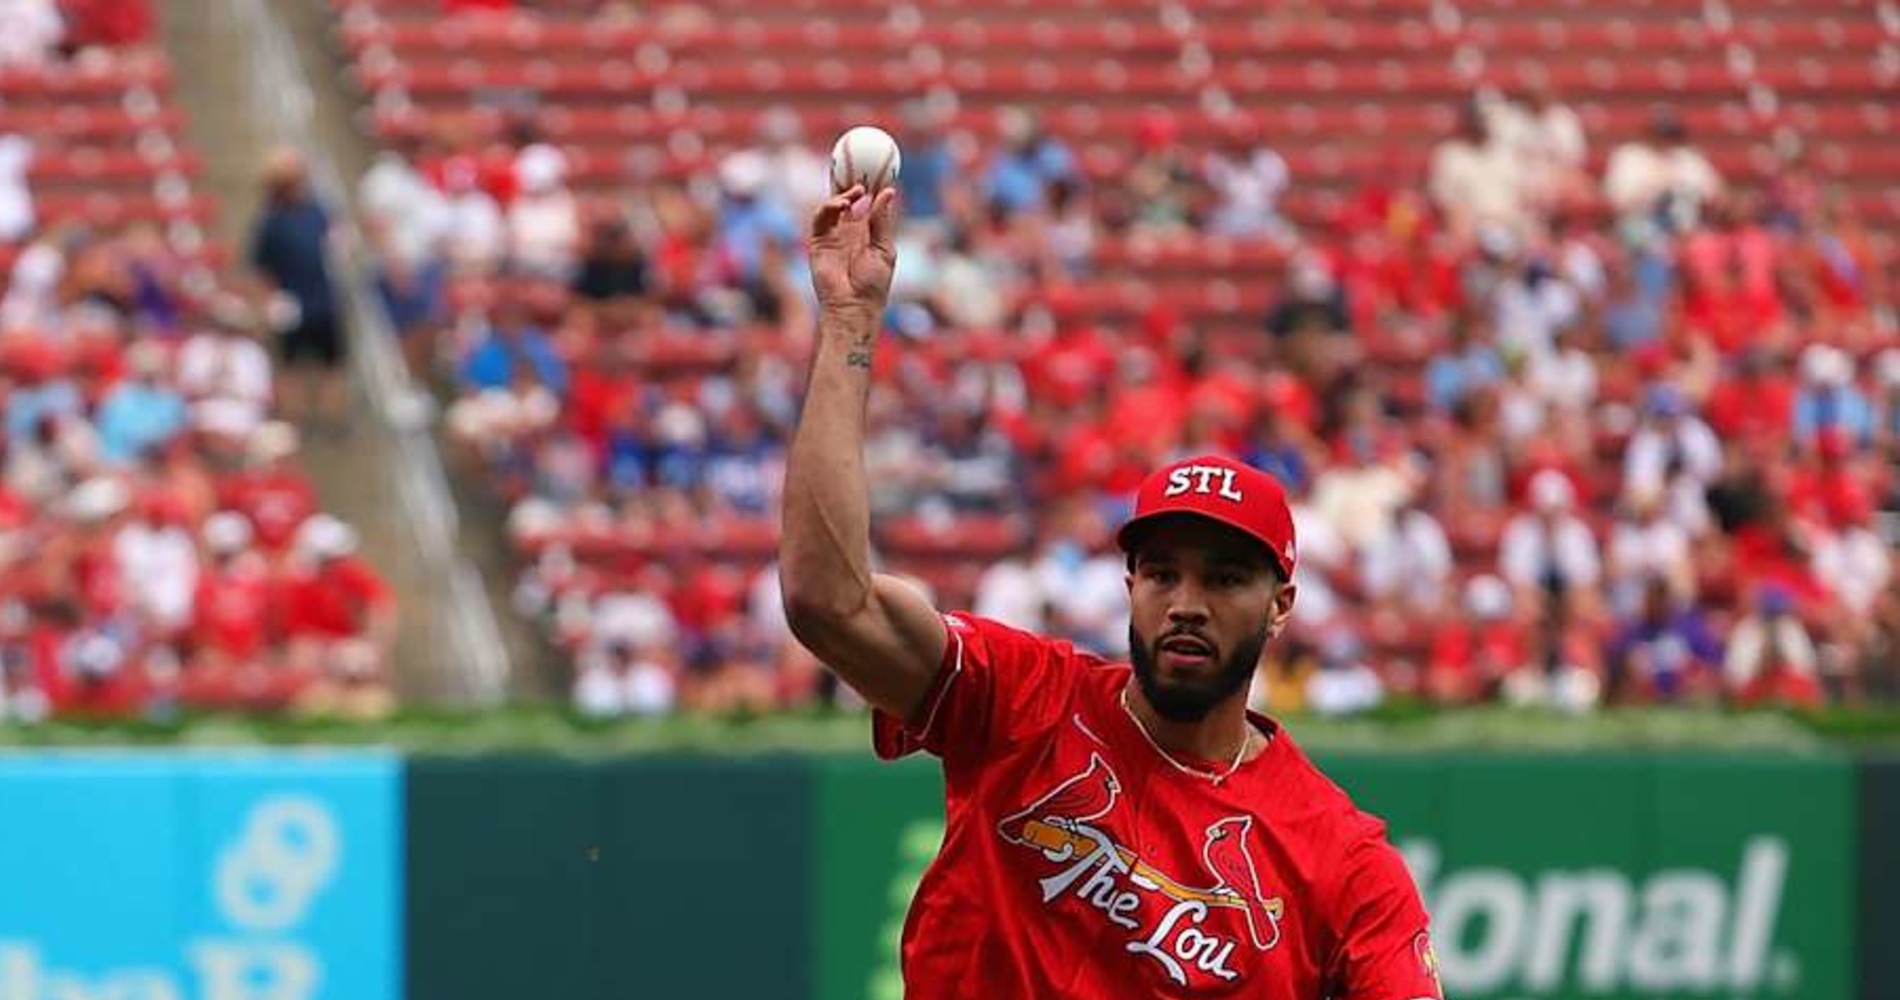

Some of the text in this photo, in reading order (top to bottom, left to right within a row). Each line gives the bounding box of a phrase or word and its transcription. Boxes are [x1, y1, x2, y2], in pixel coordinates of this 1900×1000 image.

[1165, 465, 1243, 502] STL
[1038, 817, 1238, 987] The Lou
